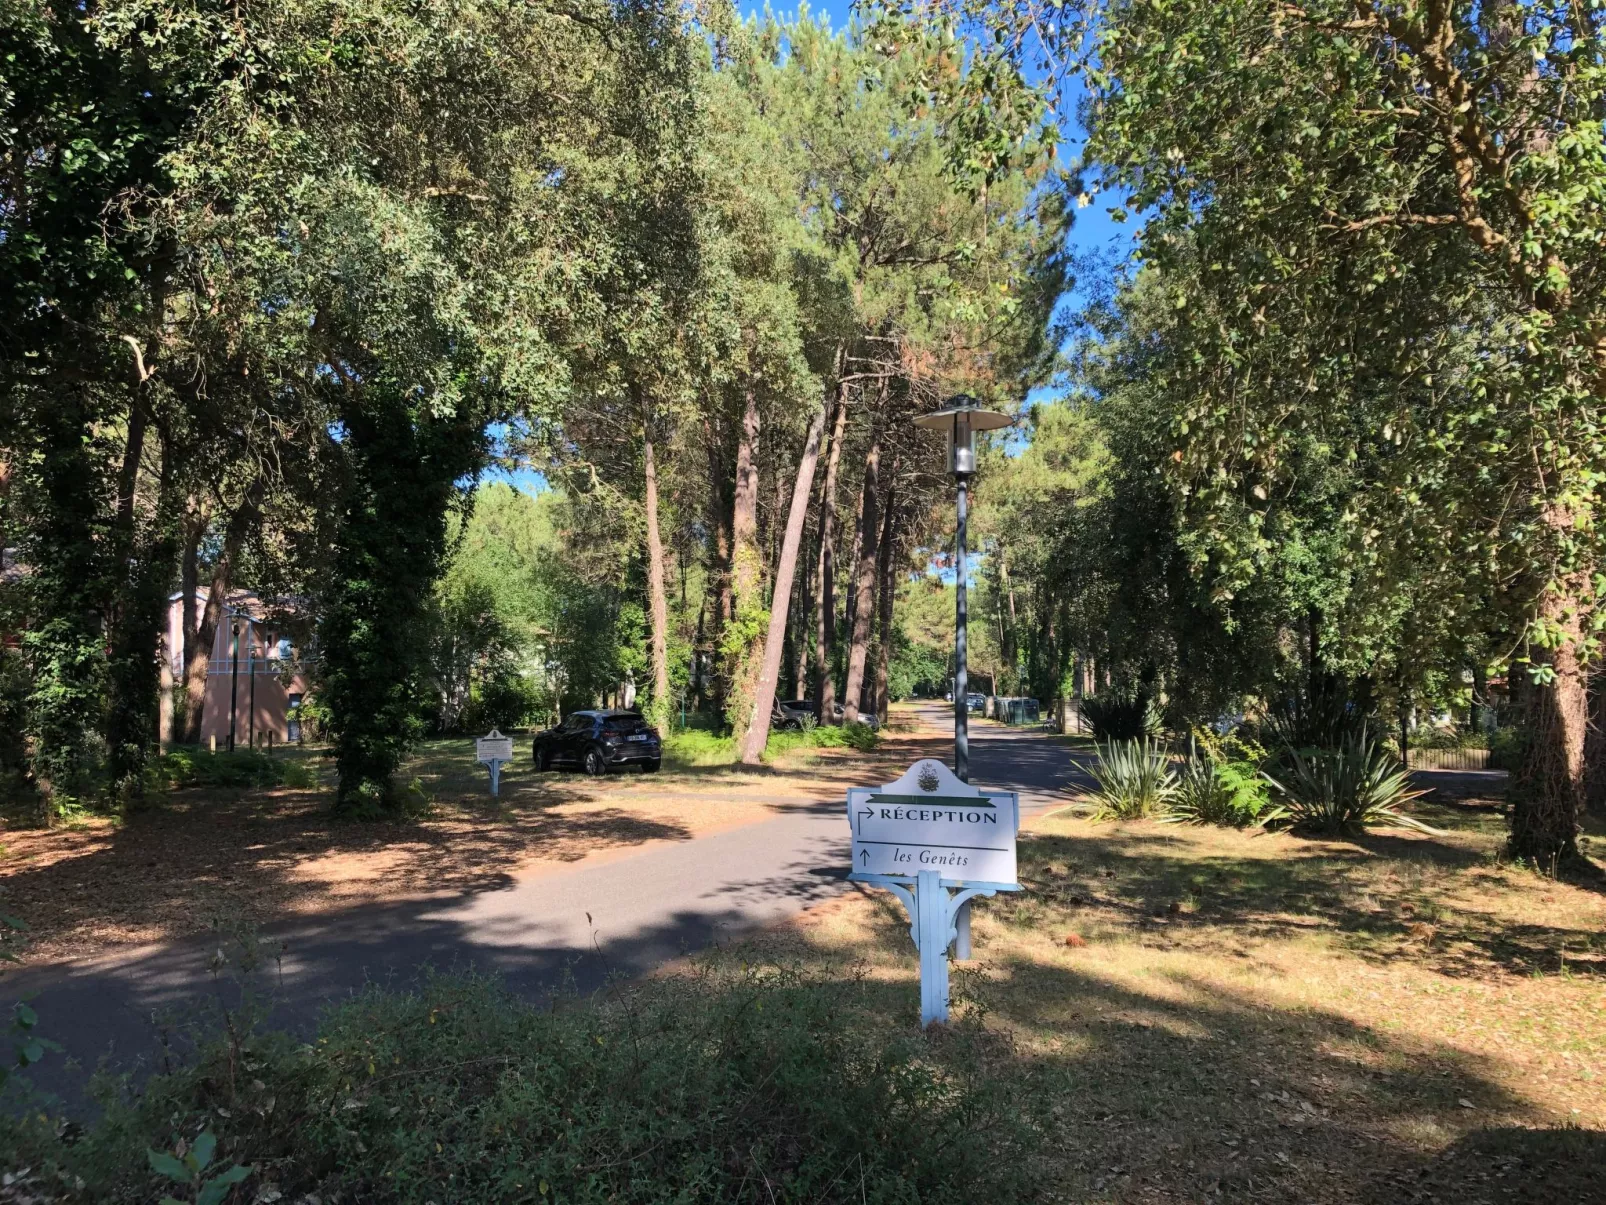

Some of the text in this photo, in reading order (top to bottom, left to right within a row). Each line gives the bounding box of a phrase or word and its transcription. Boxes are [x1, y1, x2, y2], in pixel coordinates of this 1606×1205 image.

[880, 807, 997, 824] RÉCEPTION
[893, 848, 969, 866] les Genêts
